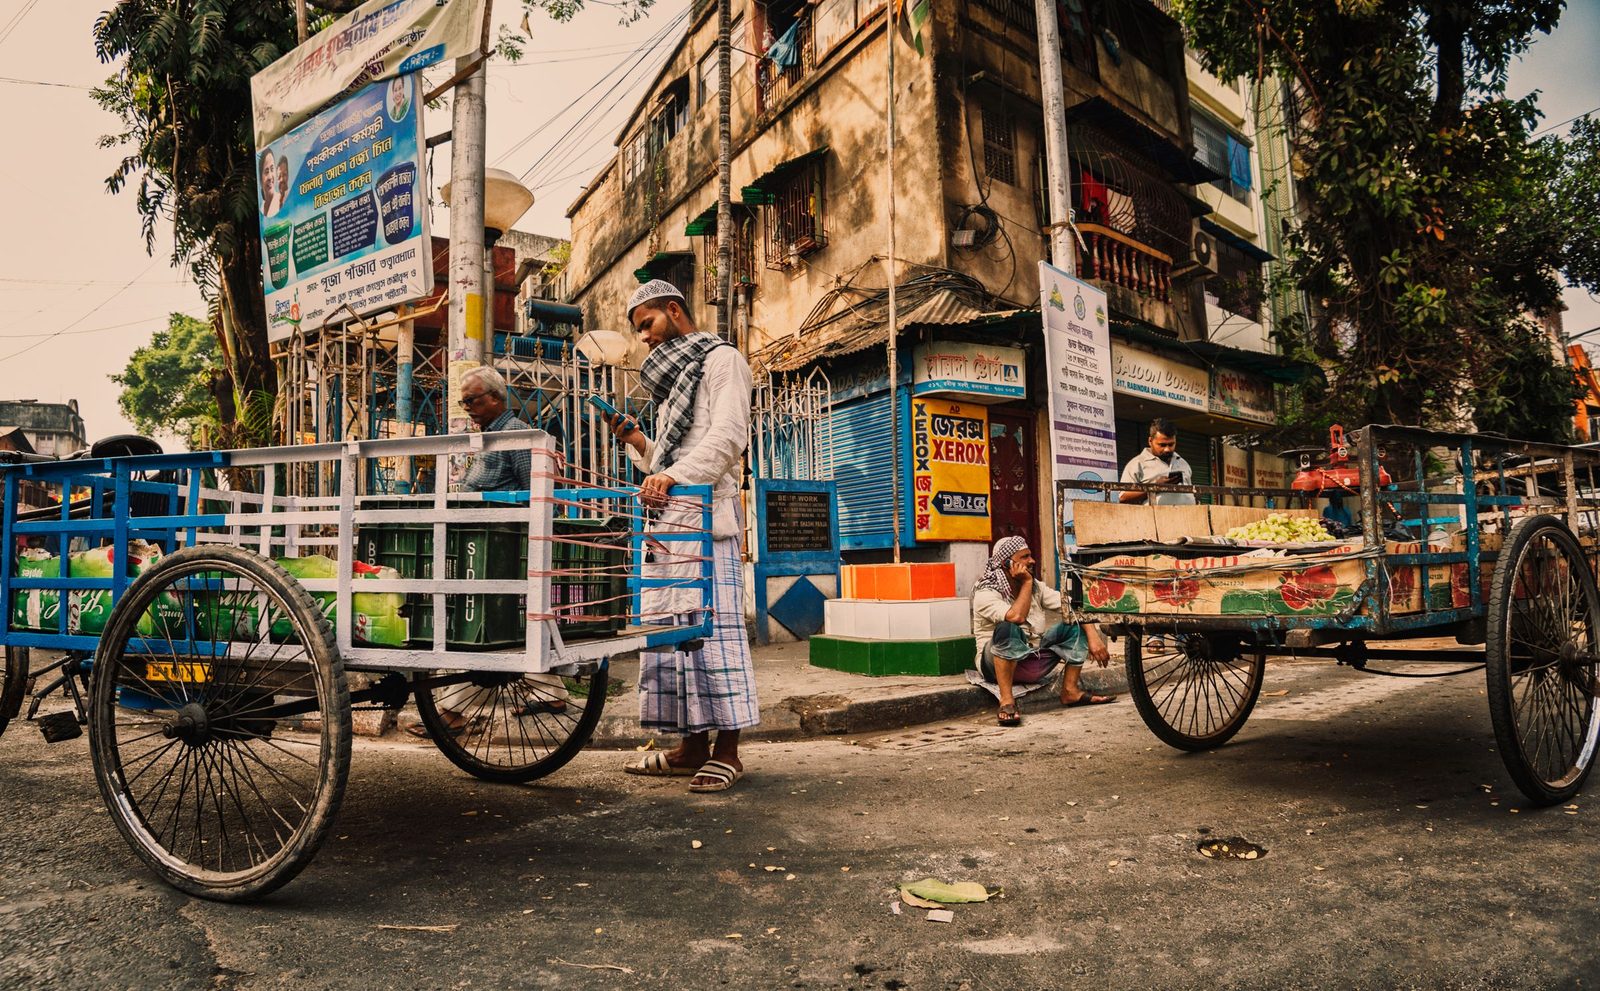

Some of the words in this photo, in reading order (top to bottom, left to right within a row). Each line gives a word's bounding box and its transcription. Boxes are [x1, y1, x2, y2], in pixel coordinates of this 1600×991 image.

[326, 161, 347, 181] আগে
[313, 183, 346, 210] বিভাজন
[348, 169, 372, 194] করুন
[320, 271, 341, 293] পূজা
[345, 258, 376, 282] পাঁজার
[1127, 381, 1151, 395] RABINDRA
[1168, 389, 1187, 403] KOLKATA
[949, 405, 961, 414] AD
[914, 402, 930, 471] XEROX
[930, 413, 985, 442] জেরক্স
[932, 439, 987, 465] XEROX
[1114, 558, 1136, 567] ANAR
